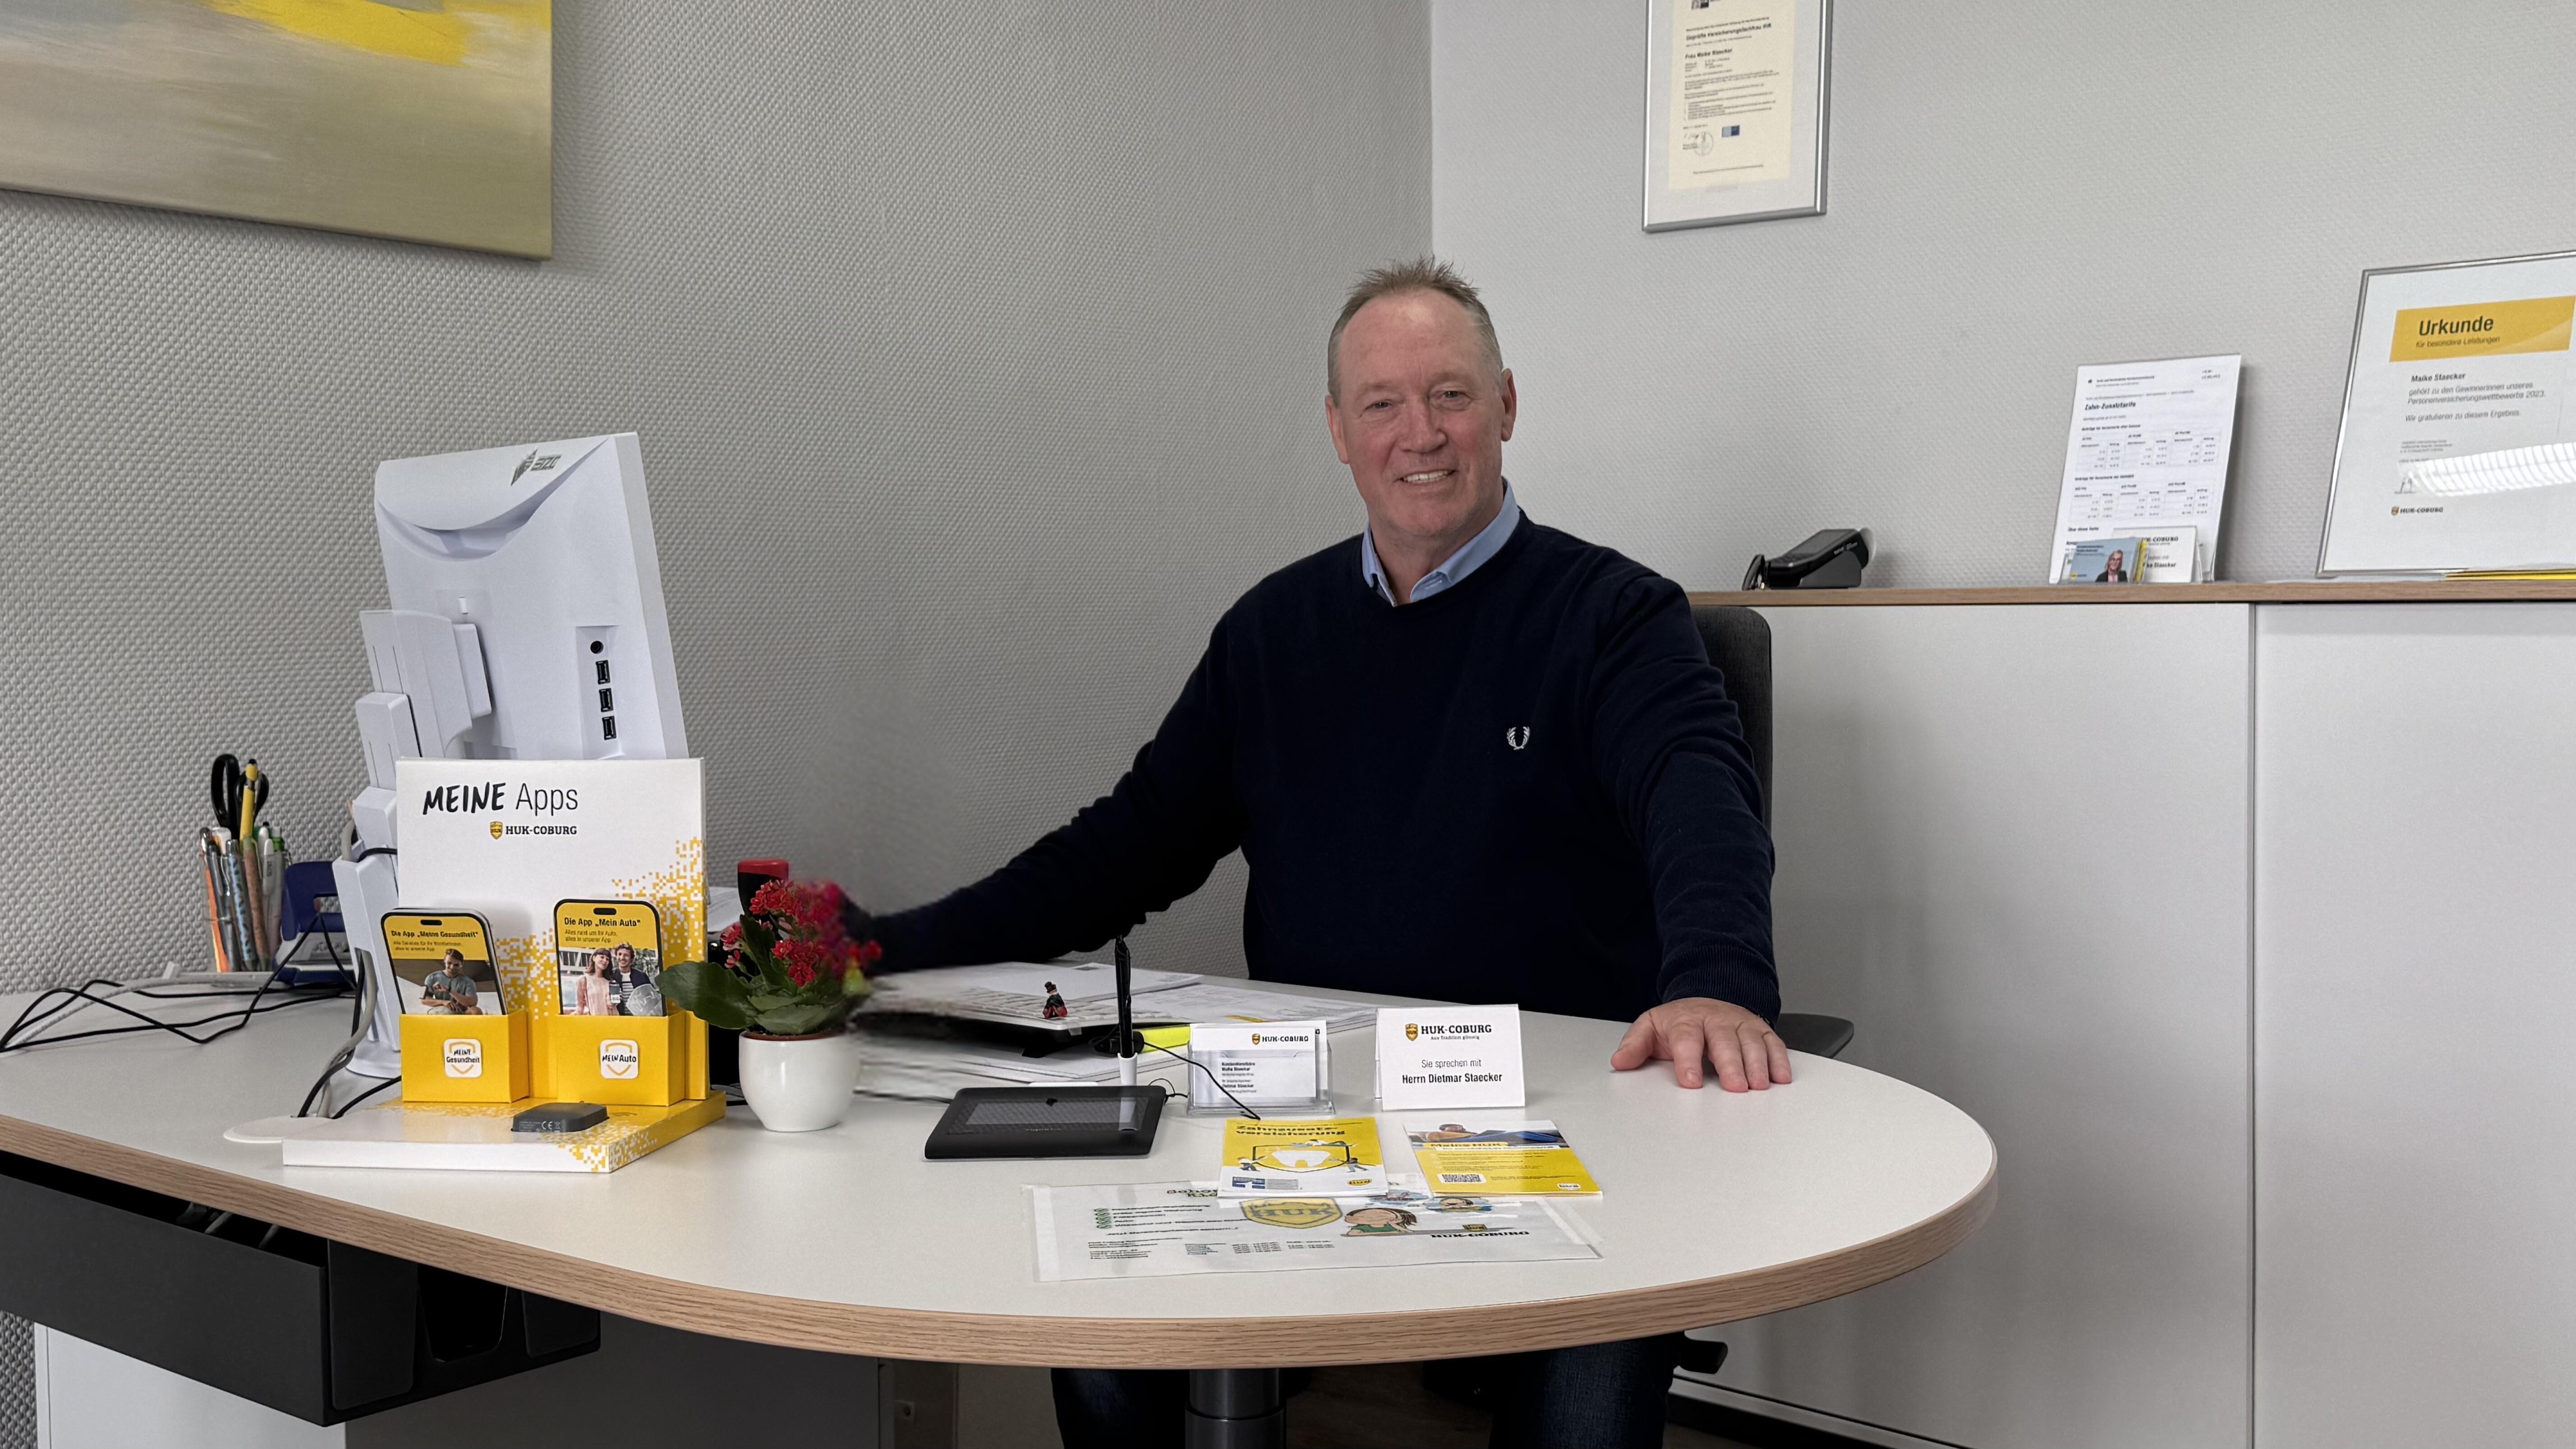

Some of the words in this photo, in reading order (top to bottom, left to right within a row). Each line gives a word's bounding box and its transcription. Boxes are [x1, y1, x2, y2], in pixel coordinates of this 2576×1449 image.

[2420, 316, 2494, 336] Urkunde
[2427, 337, 2462, 348] besondere
[2463, 336, 2500, 347] Leistungen
[2435, 373, 2466, 382] Staecker
[2409, 387, 2430, 396] gehört
[2441, 386, 2454, 394] den
[2418, 413, 2453, 423] gratulieren
[422, 781, 506, 815] MEINE
[515, 782, 579, 816] Apps
[505, 825, 577, 836] HUK-COBURG
[564, 917, 576, 925] Die
[578, 918, 593, 927] App
[1421, 1024, 1492, 1035] HUK-COBURG
[446, 1056, 480, 1064] Gesundheit
[619, 1055, 637, 1063] Auto
[1421, 1060, 1433, 1068] Sie
[1435, 1059, 1467, 1069] sprechen
[1470, 1058, 1481, 1067] mit
[1402, 1074, 1426, 1084] Herrn
[1429, 1073, 1462, 1083] Dietmar
[1464, 1072, 1502, 1082] Staecker
[1252, 1208, 1338, 1217] HUK
